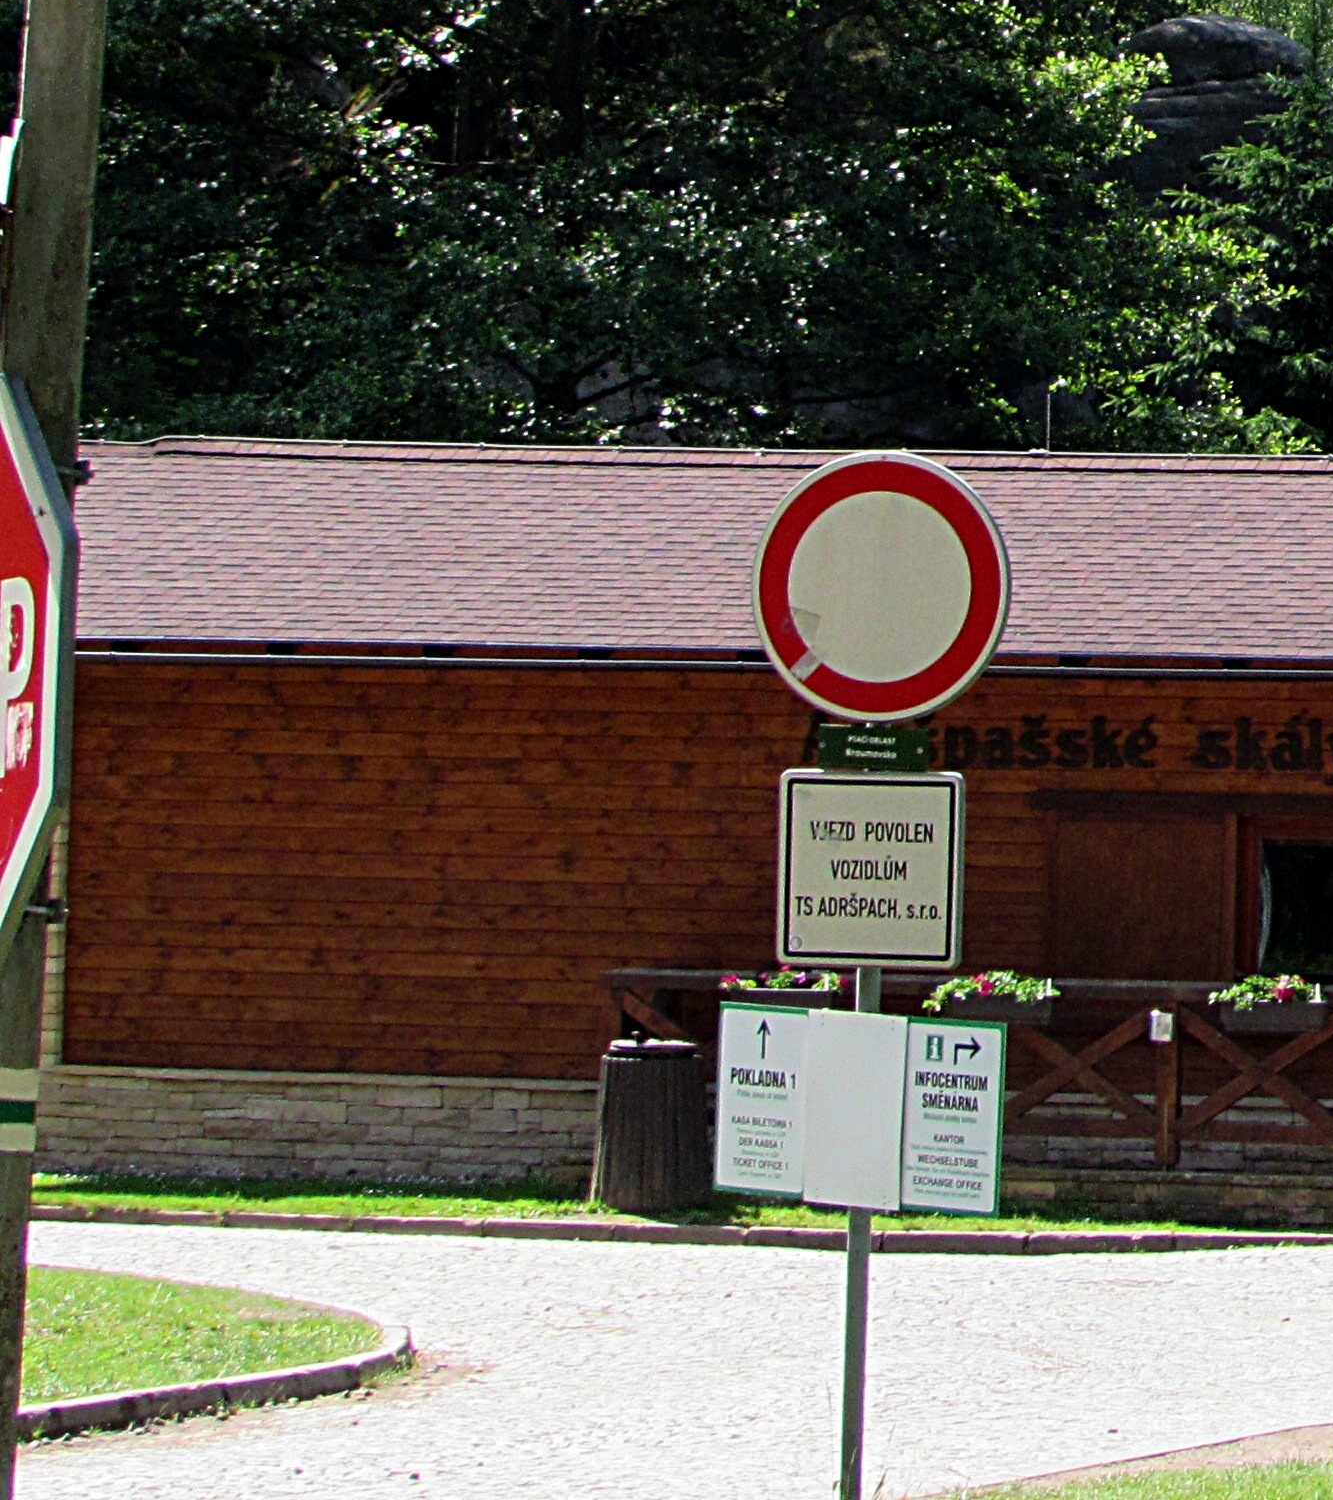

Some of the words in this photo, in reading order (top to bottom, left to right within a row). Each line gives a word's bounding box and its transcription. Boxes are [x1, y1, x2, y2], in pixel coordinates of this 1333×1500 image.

[810, 820, 856, 842] VJEZD
[865, 821, 934, 843] POVOLEN
[831, 854, 908, 881] VOZIDLŮM
[795, 896, 813, 917] TS
[817, 891, 902, 920] ADRŠPACH,
[906, 903, 943, 921] s.r.o.
[730, 1067, 787, 1089] POKLADNA
[790, 1073, 796, 1090] 1
[914, 1070, 988, 1092] INFOCENTRUM
[922, 1089, 979, 1112] SMĚNÁRNA
[933, 1133, 965, 1145] KANTOR
[732, 1156, 757, 1168] TICKET
[758, 1158, 783, 1171] OFFICE
[913, 1175, 953, 1188] EXCHANGE
[955, 1180, 983, 1192] OFFICE
